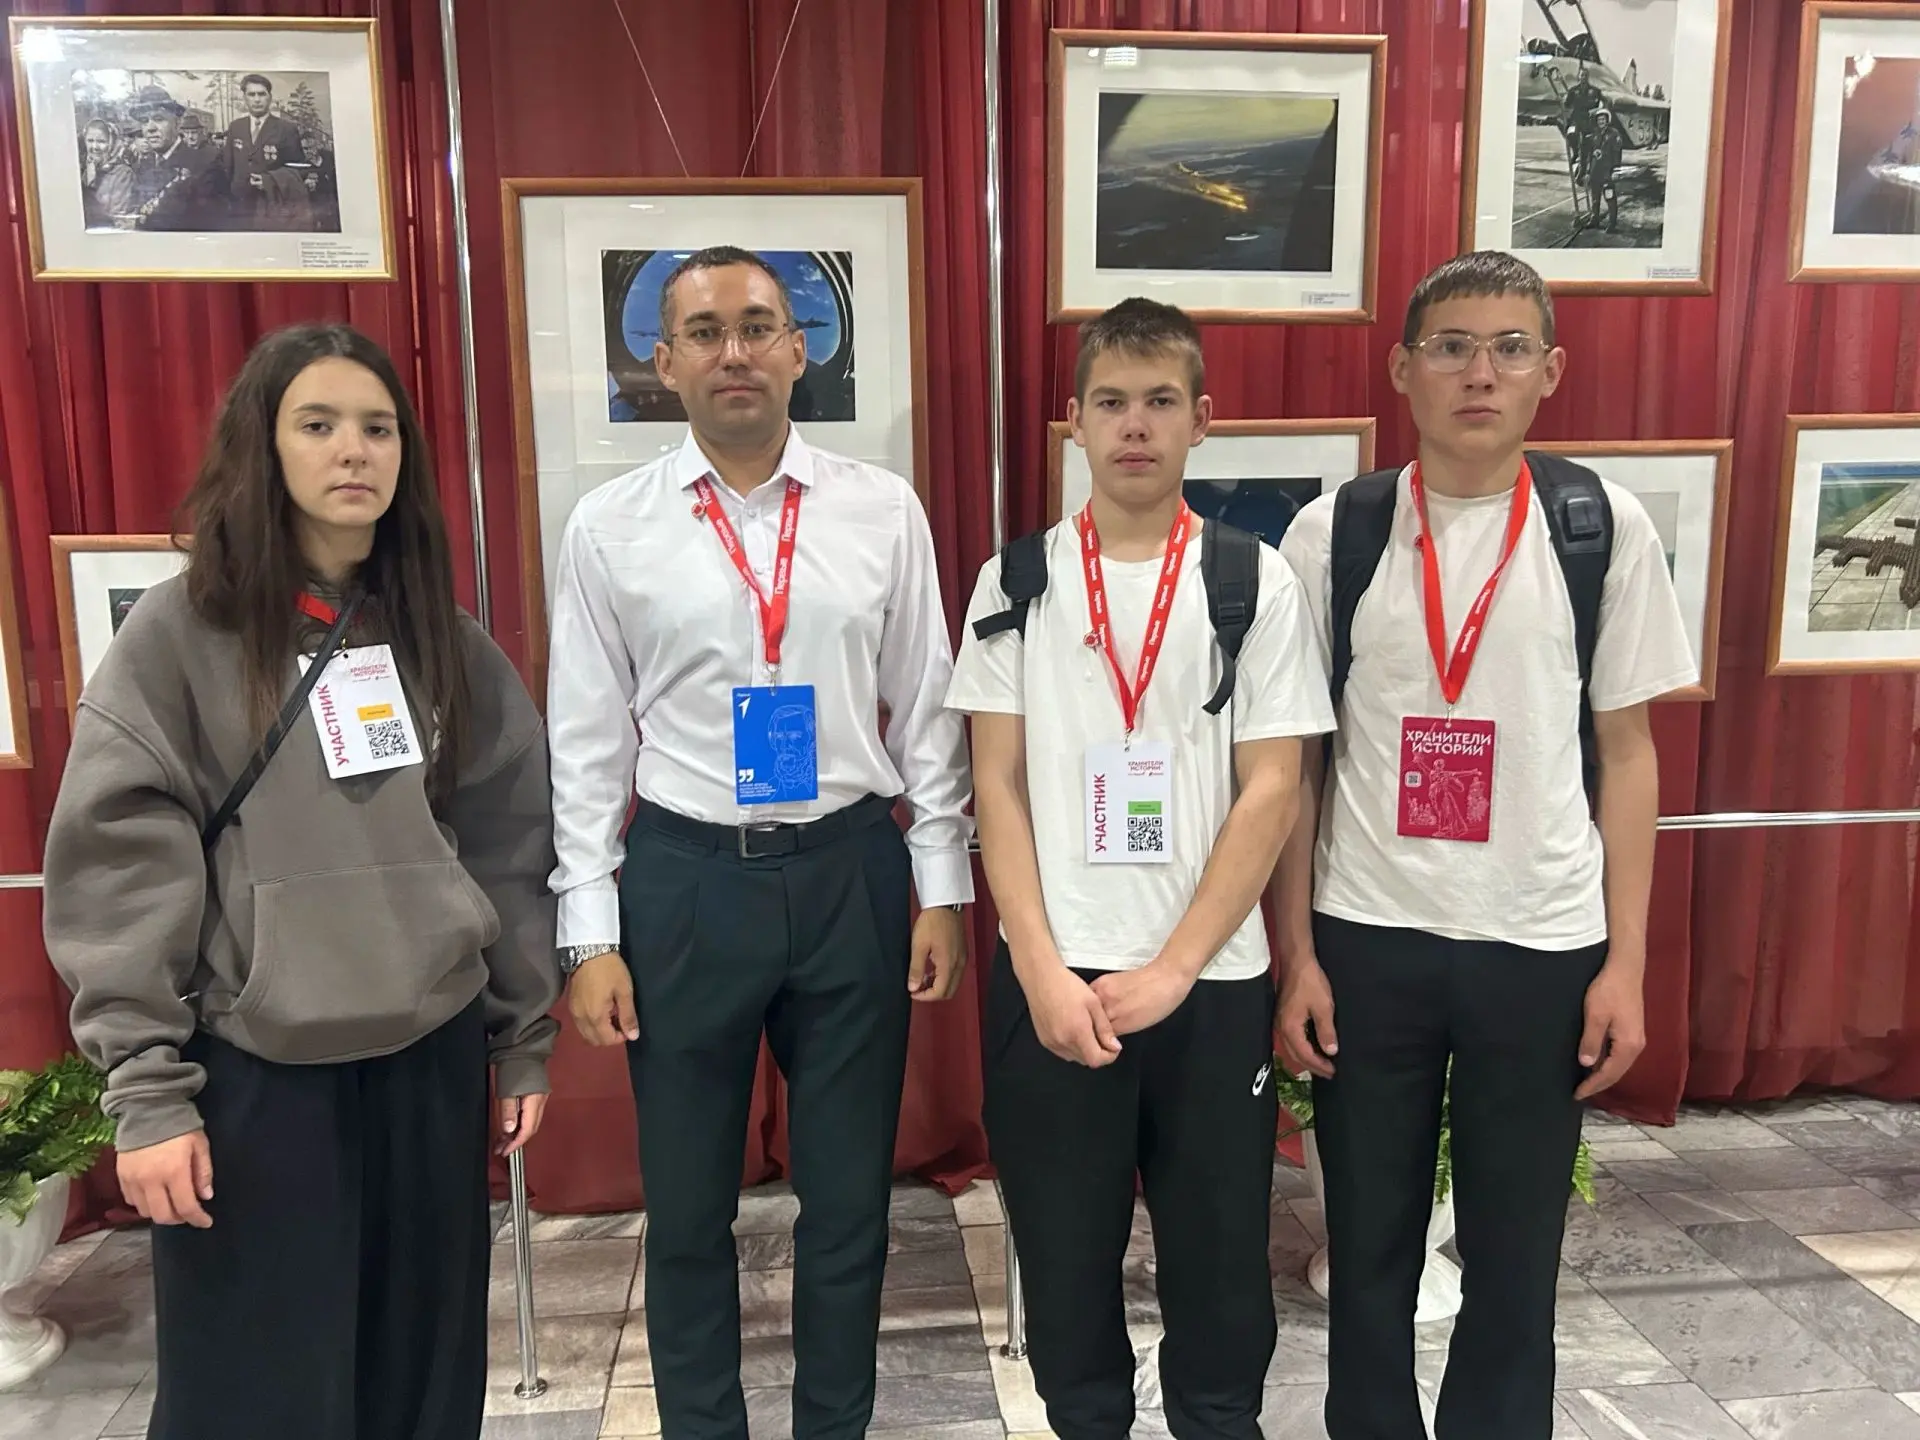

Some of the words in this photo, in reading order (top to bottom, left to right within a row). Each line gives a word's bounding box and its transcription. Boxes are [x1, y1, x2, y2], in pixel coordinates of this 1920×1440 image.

[716, 518, 737, 555] Первые
[781, 507, 794, 542] Первые
[774, 556, 788, 595] Первые
[315, 683, 350, 767] УЧАСТНИК
[1405, 730, 1492, 745] ХРАНИТЕЛИ
[1412, 742, 1484, 756] ИСТОРИИ
[1094, 773, 1107, 853] УЧАСТНИК
